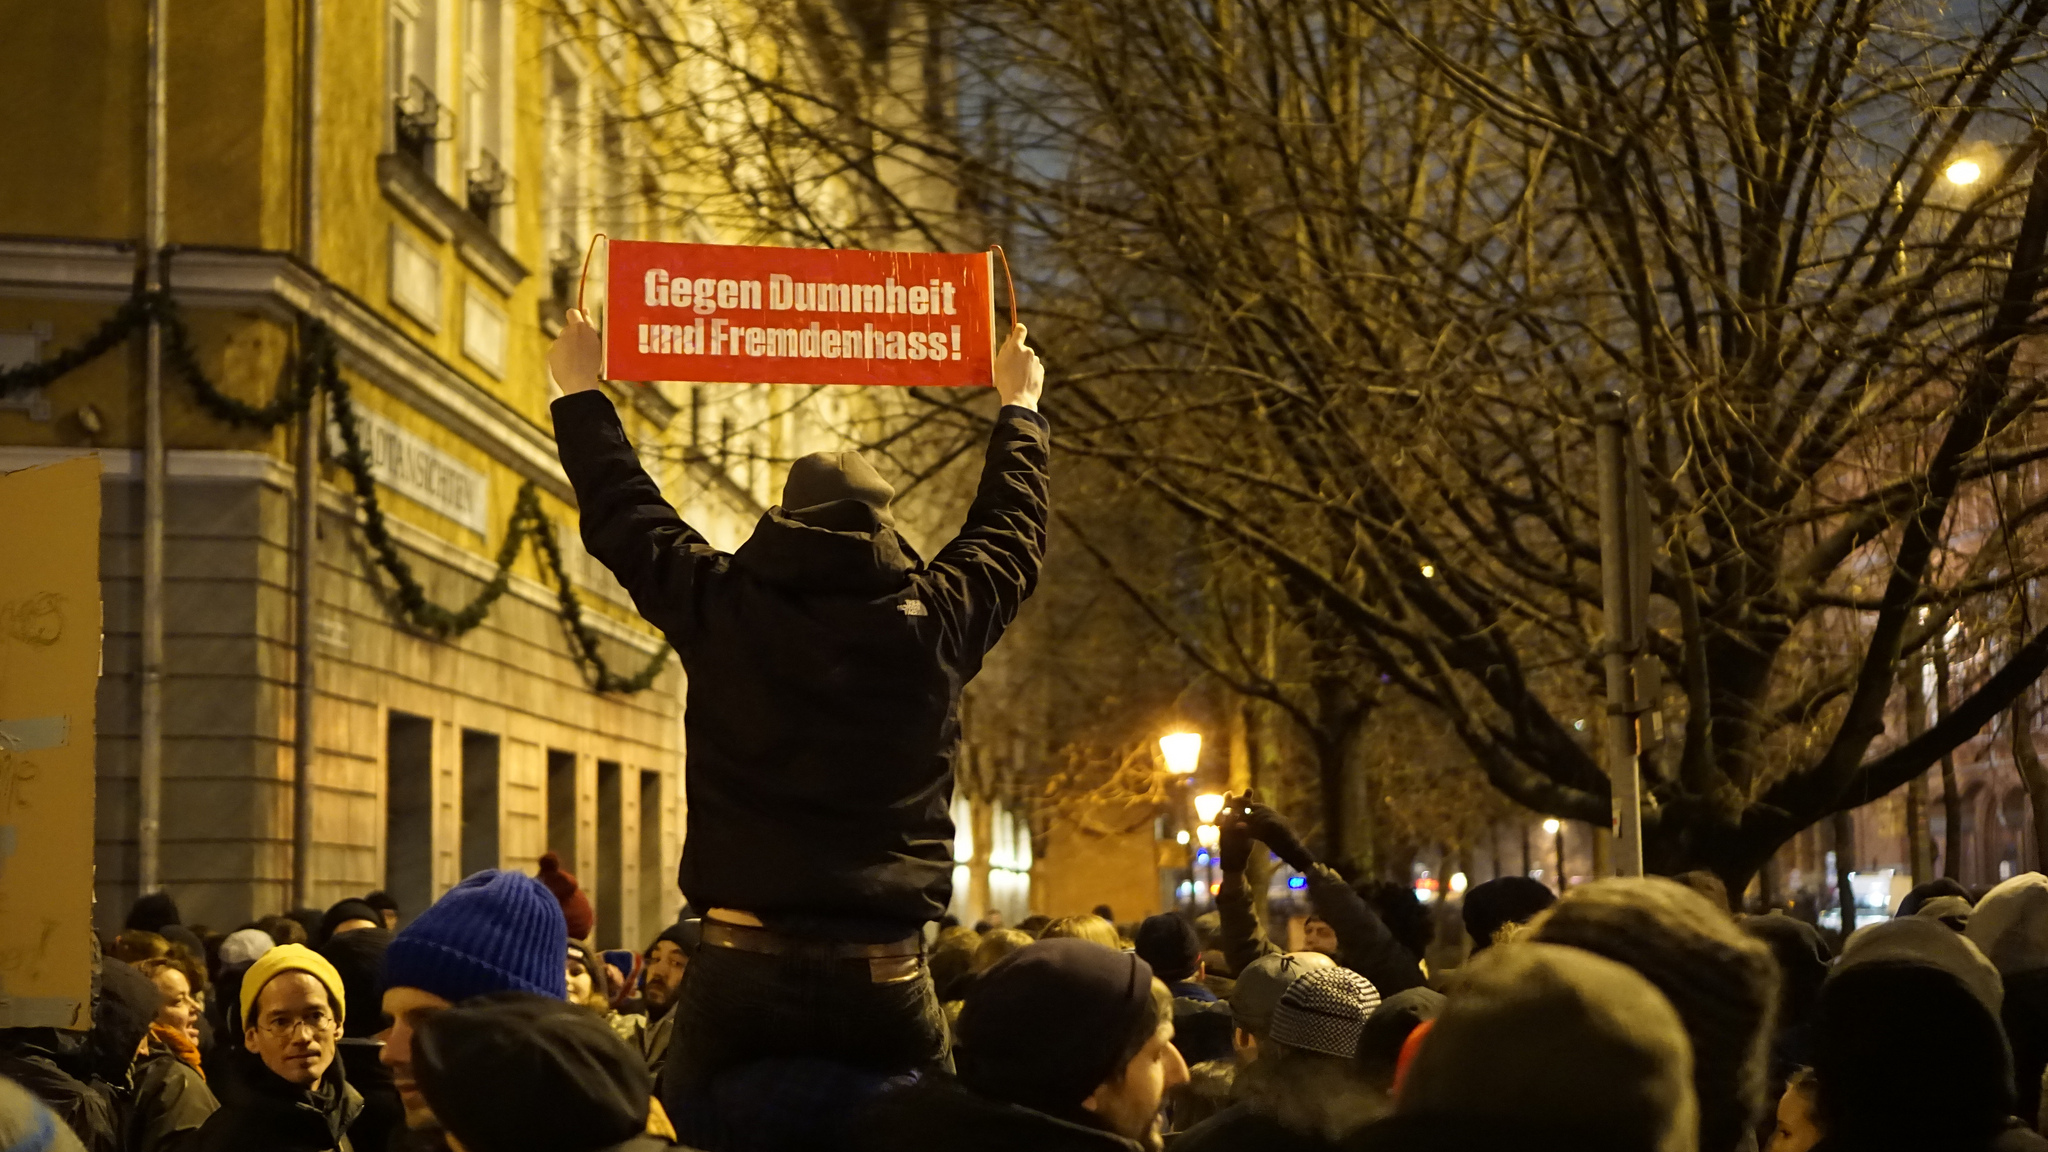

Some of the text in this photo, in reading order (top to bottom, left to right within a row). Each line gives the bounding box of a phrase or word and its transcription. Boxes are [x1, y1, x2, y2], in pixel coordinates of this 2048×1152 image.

[644, 268, 958, 317] Gegen Dummheit
[637, 317, 962, 362] und Fremdenhass!
